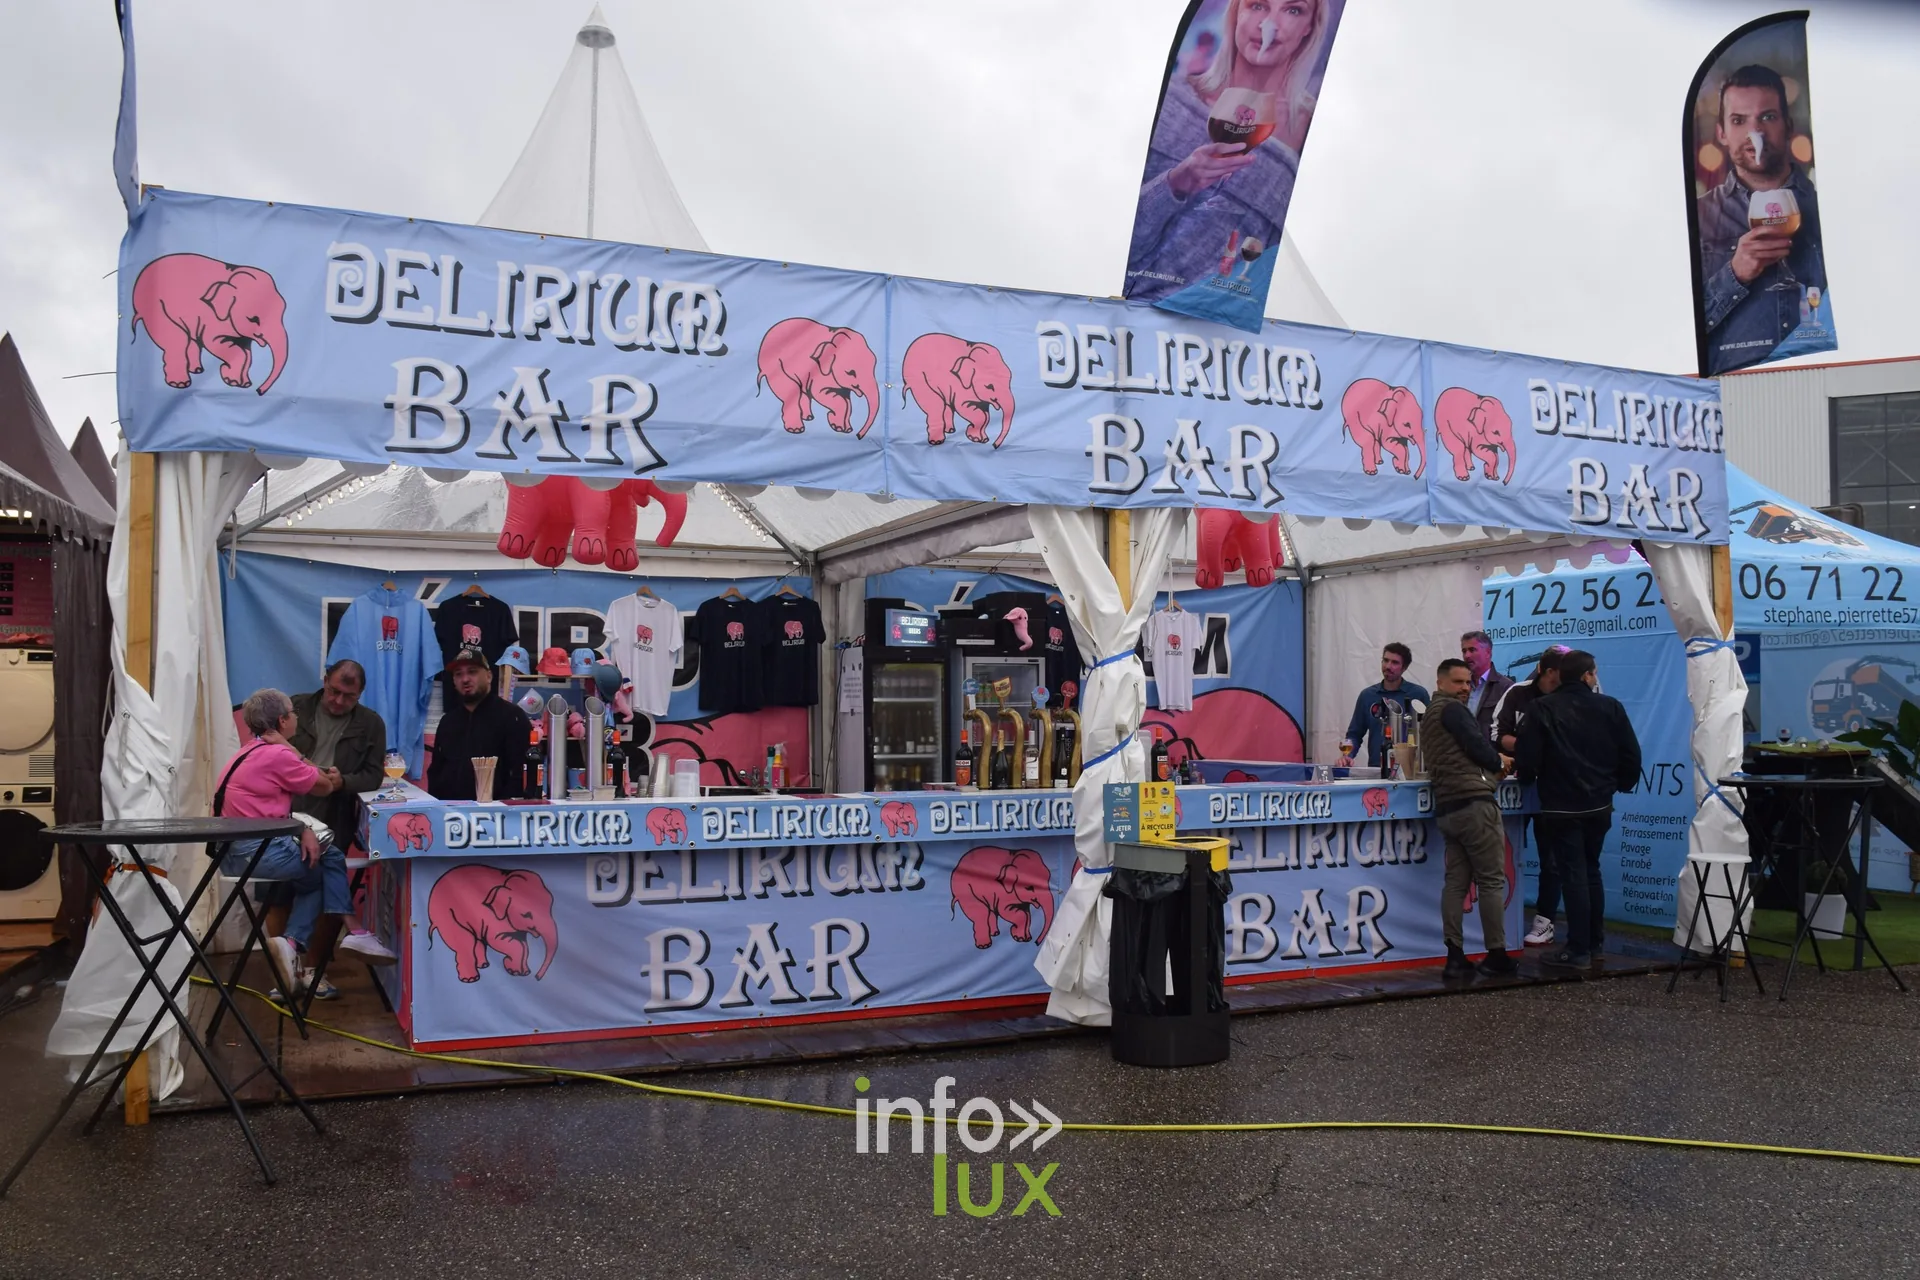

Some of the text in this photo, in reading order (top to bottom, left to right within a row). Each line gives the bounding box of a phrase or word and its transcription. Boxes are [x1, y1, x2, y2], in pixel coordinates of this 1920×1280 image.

[325, 241, 728, 356] DELIRIUM
[1035, 320, 1323, 411] DELIRIUM
[384, 357, 668, 475] BAR
[1527, 377, 1725, 454] DELIRIUM
[1085, 413, 1285, 509] BAR
[1567, 456, 1711, 540] BAR
[1485, 571, 1666, 621] 71 22 56 2
[1738, 563, 1908, 602] 06 71 22
[1484, 614, 1657, 641] ane.pierrette57@gmail.com
[1621, 763, 1686, 797] NTS
[702, 803, 872, 842] DELIRIUM
[1208, 790, 1333, 824] DELIRIUM
[1621, 812, 1688, 827] Aménagement
[444, 809, 633, 849] DELIRIUM
[1115, 824, 1132, 832] JETER
[1147, 823, 1174, 831] RECYCLER
[1205, 818, 1428, 873] ELIRIUM
[1621, 826, 1685, 841] Terrassement
[1620, 842, 1651, 857] Pavage
[1620, 856, 1653, 870] Enrobé
[585, 842, 925, 908] DELIRIUM
[1621, 871, 1677, 887] Maçonnerie
[1622, 886, 1674, 902] Rénovation
[1226, 885, 1395, 965] BAR
[640, 917, 880, 1013] BAR
